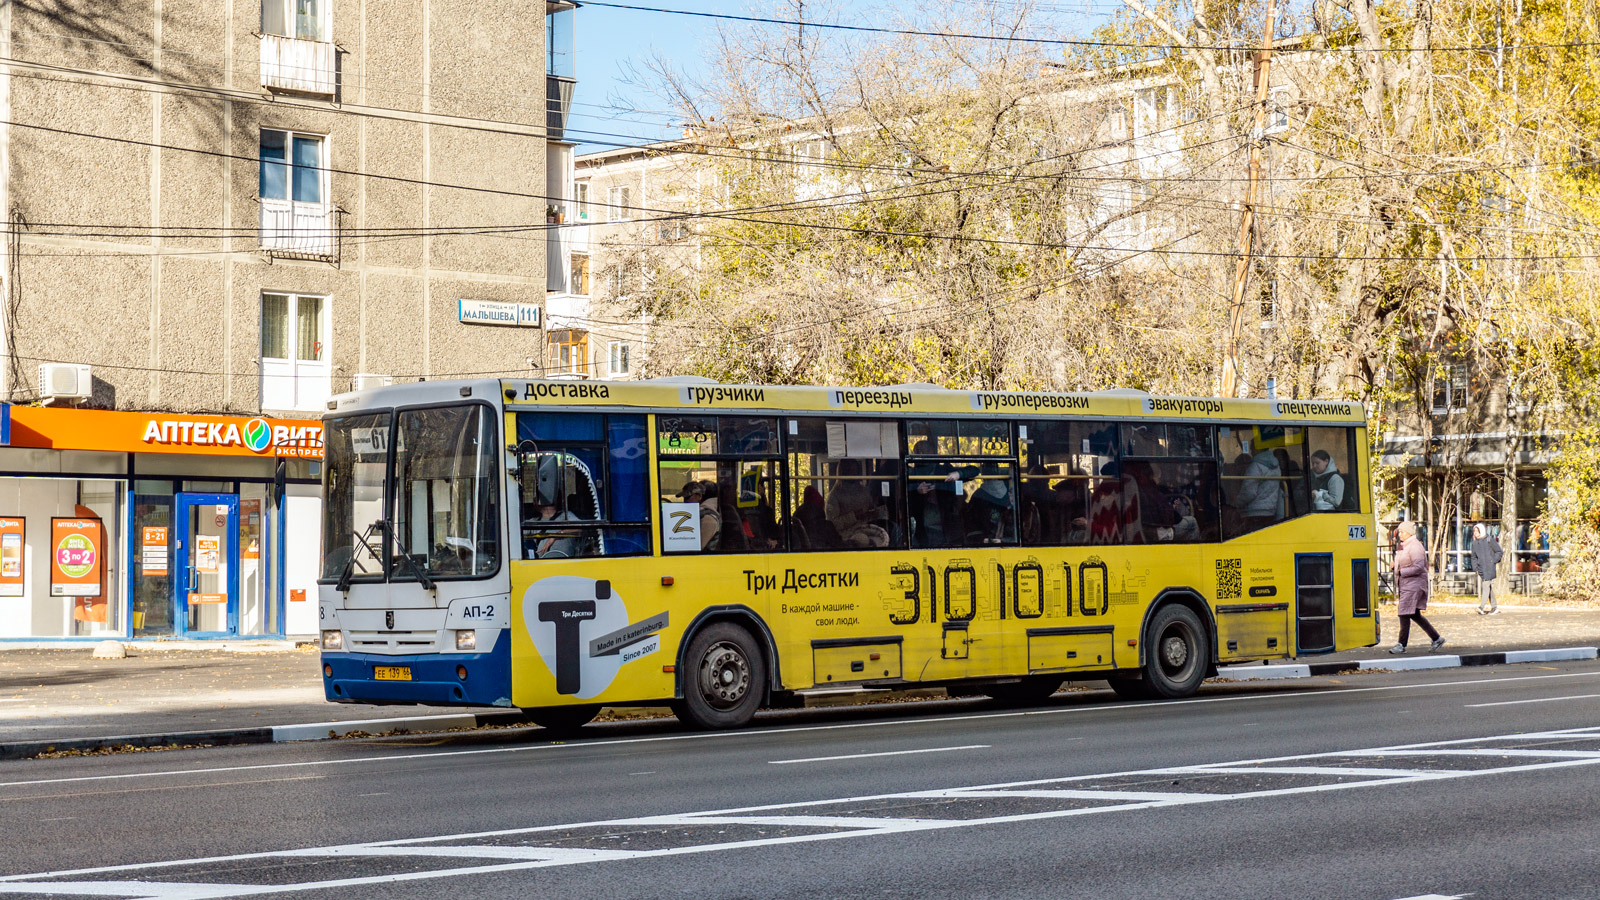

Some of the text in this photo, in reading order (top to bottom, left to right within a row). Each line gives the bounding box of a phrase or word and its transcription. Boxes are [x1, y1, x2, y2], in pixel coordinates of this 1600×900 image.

[463, 307, 537, 321] МАЛЫШЕВА 111
[524, 382, 610, 401] доставка
[687, 386, 765, 404] грузчики
[835, 388, 913, 406] переезды
[976, 391, 1090, 412] грузоперевозки
[1148, 397, 1224, 414] эвакуаторы
[1276, 401, 1352, 417] спецтехника
[143, 420, 242, 445] АПТЕКА
[371, 428, 386, 450] 61
[276, 448, 324, 456] ЭКСПРЕС
[669, 511, 695, 533] Z
[1348, 526, 1366, 539] 478
[61, 549, 71, 564] 3
[82, 550, 91, 564] 2
[743, 568, 859, 594] Три Десятки
[463, 605, 495, 618] АП-2
[562, 610, 593, 618] Три Десятки
[781, 603, 788, 613] В
[790, 602, 820, 616] каждой
[822, 602, 854, 612] машине
[815, 616, 860, 628] свои люди.
[597, 640, 615, 651] Made
[623, 642, 657, 662] Since 2007
[389, 667, 400, 679] 139
